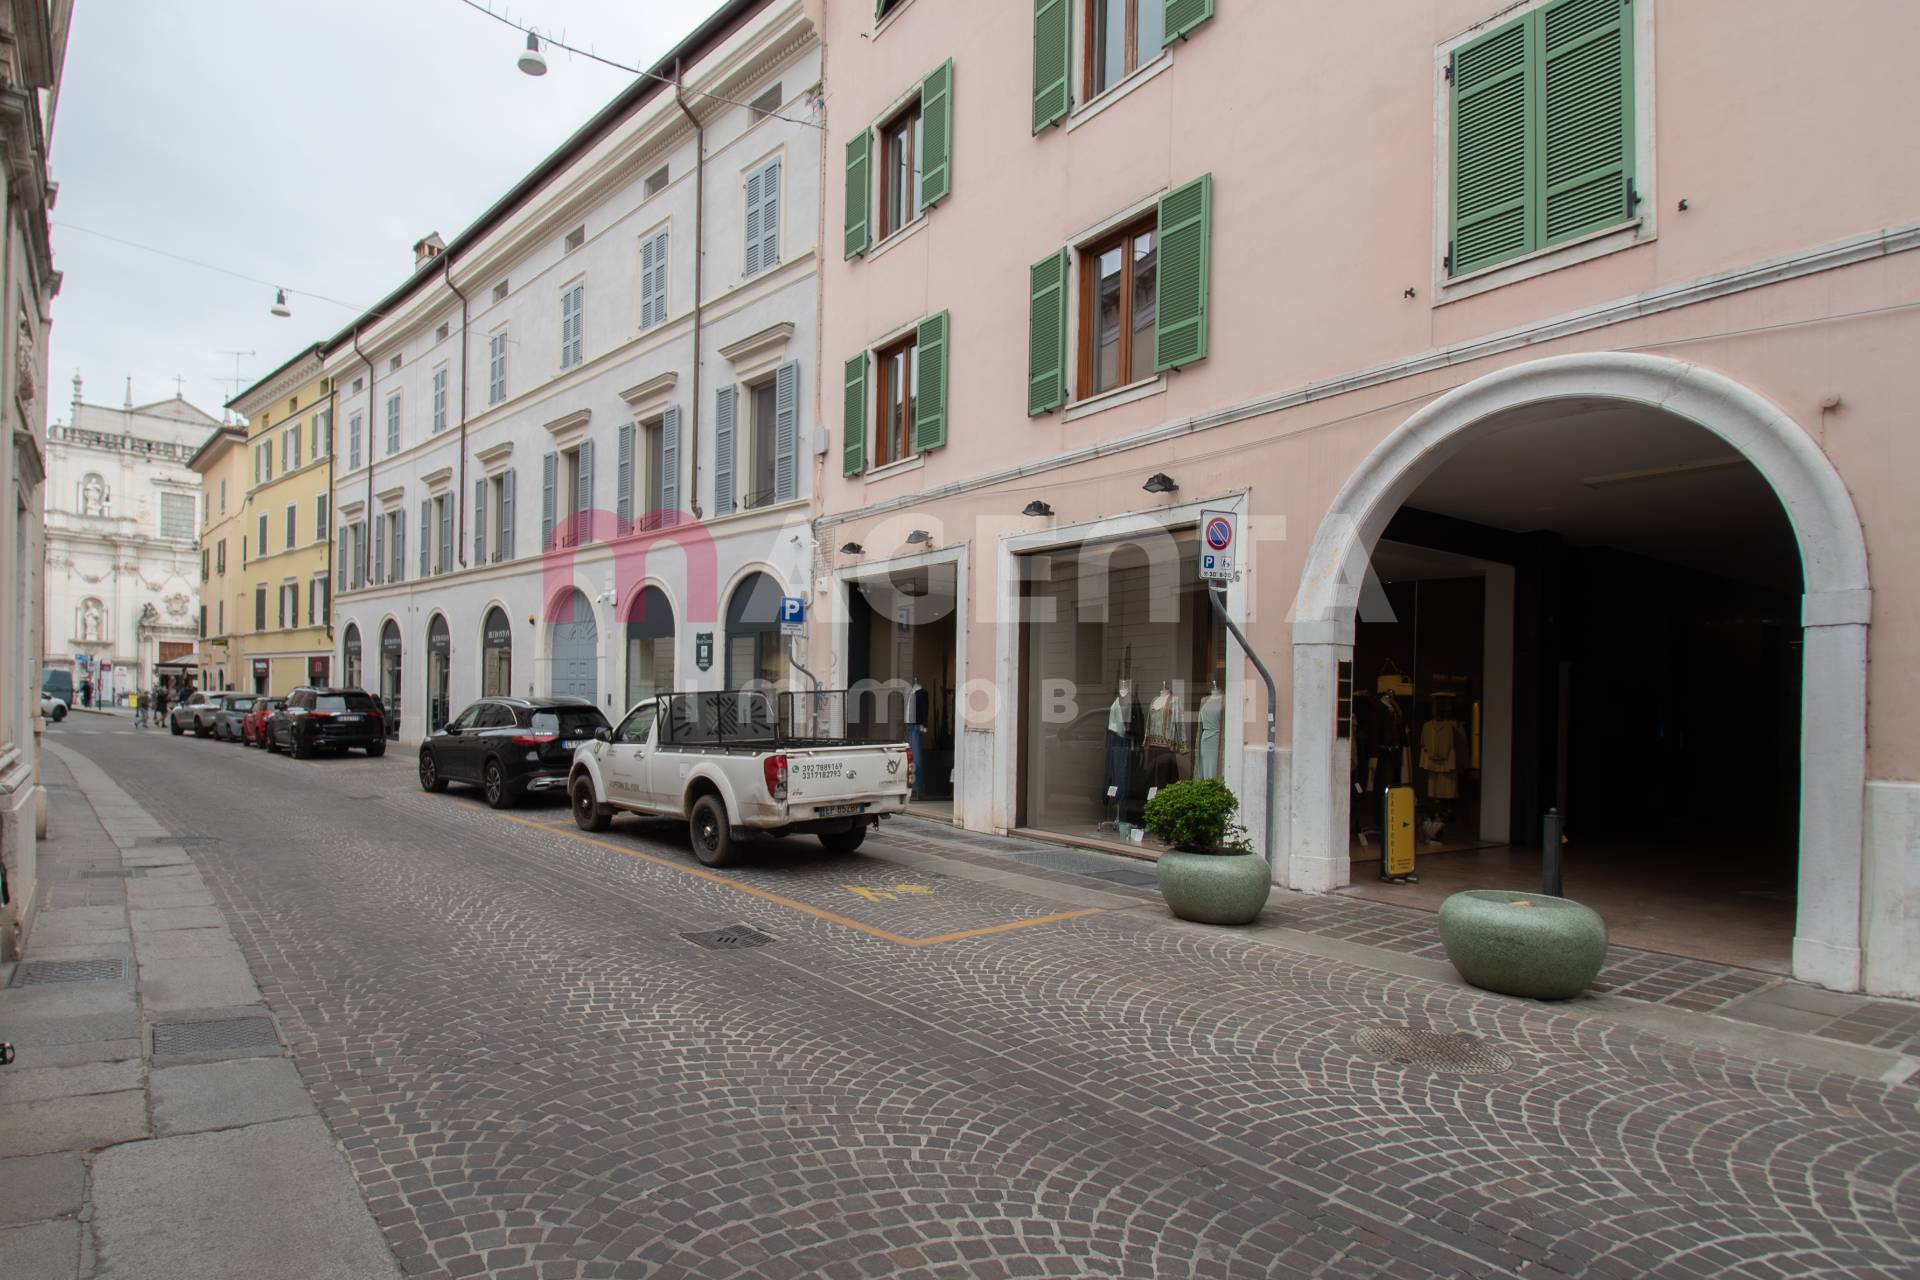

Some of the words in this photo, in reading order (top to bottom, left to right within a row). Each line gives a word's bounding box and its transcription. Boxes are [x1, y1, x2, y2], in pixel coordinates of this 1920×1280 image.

[1206, 557, 1213, 568] P
[785, 599, 800, 620] P
[802, 764, 815, 773] 392
